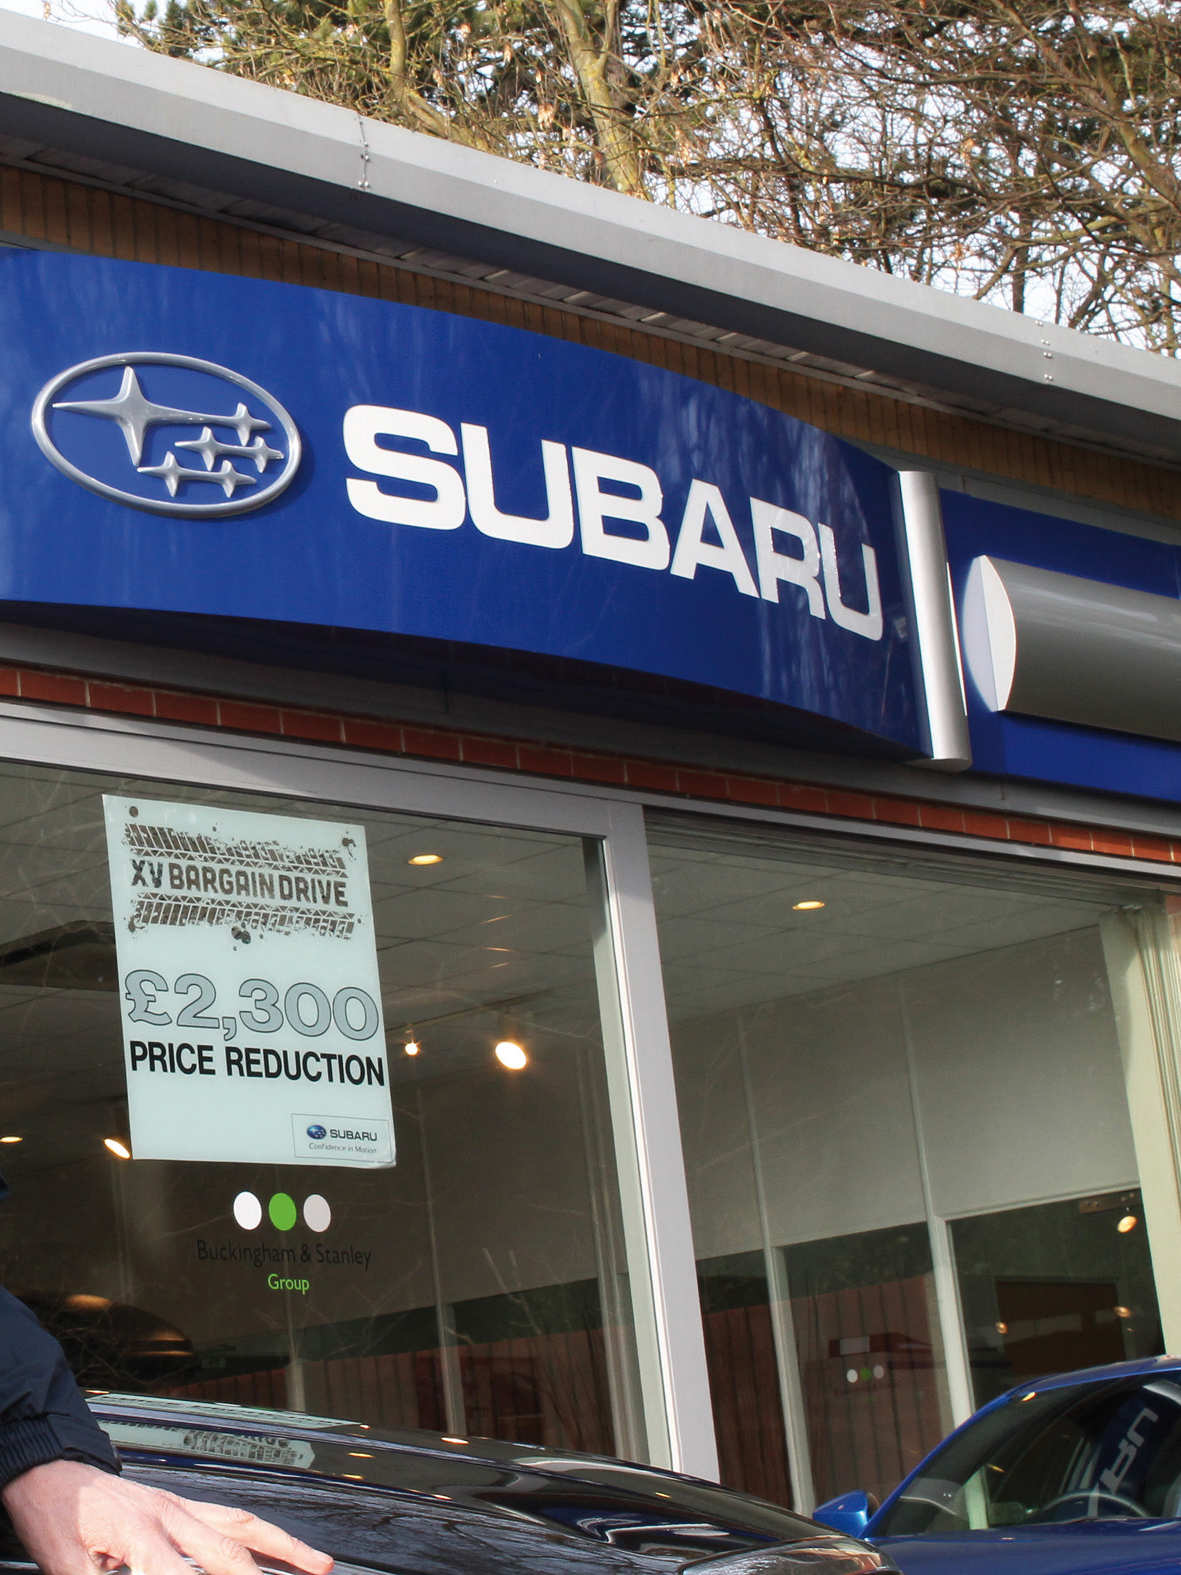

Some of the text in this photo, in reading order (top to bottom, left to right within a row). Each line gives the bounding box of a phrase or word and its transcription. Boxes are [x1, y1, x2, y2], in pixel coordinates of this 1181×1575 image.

[343, 404, 883, 641] SUBARU
[131, 859, 349, 907] XV BARGAIN DRIVE
[124, 969, 380, 1042] £2,300
[130, 1040, 385, 1086] PRICE REDUCTION
[308, 1143, 346, 1151] Confidence
[354, 1145, 377, 1154] Motion
[329, 1129, 378, 1142] SUBARU
[197, 1239, 372, 1271] Buckingham & Stanley
[267, 1273, 310, 1295] Group
